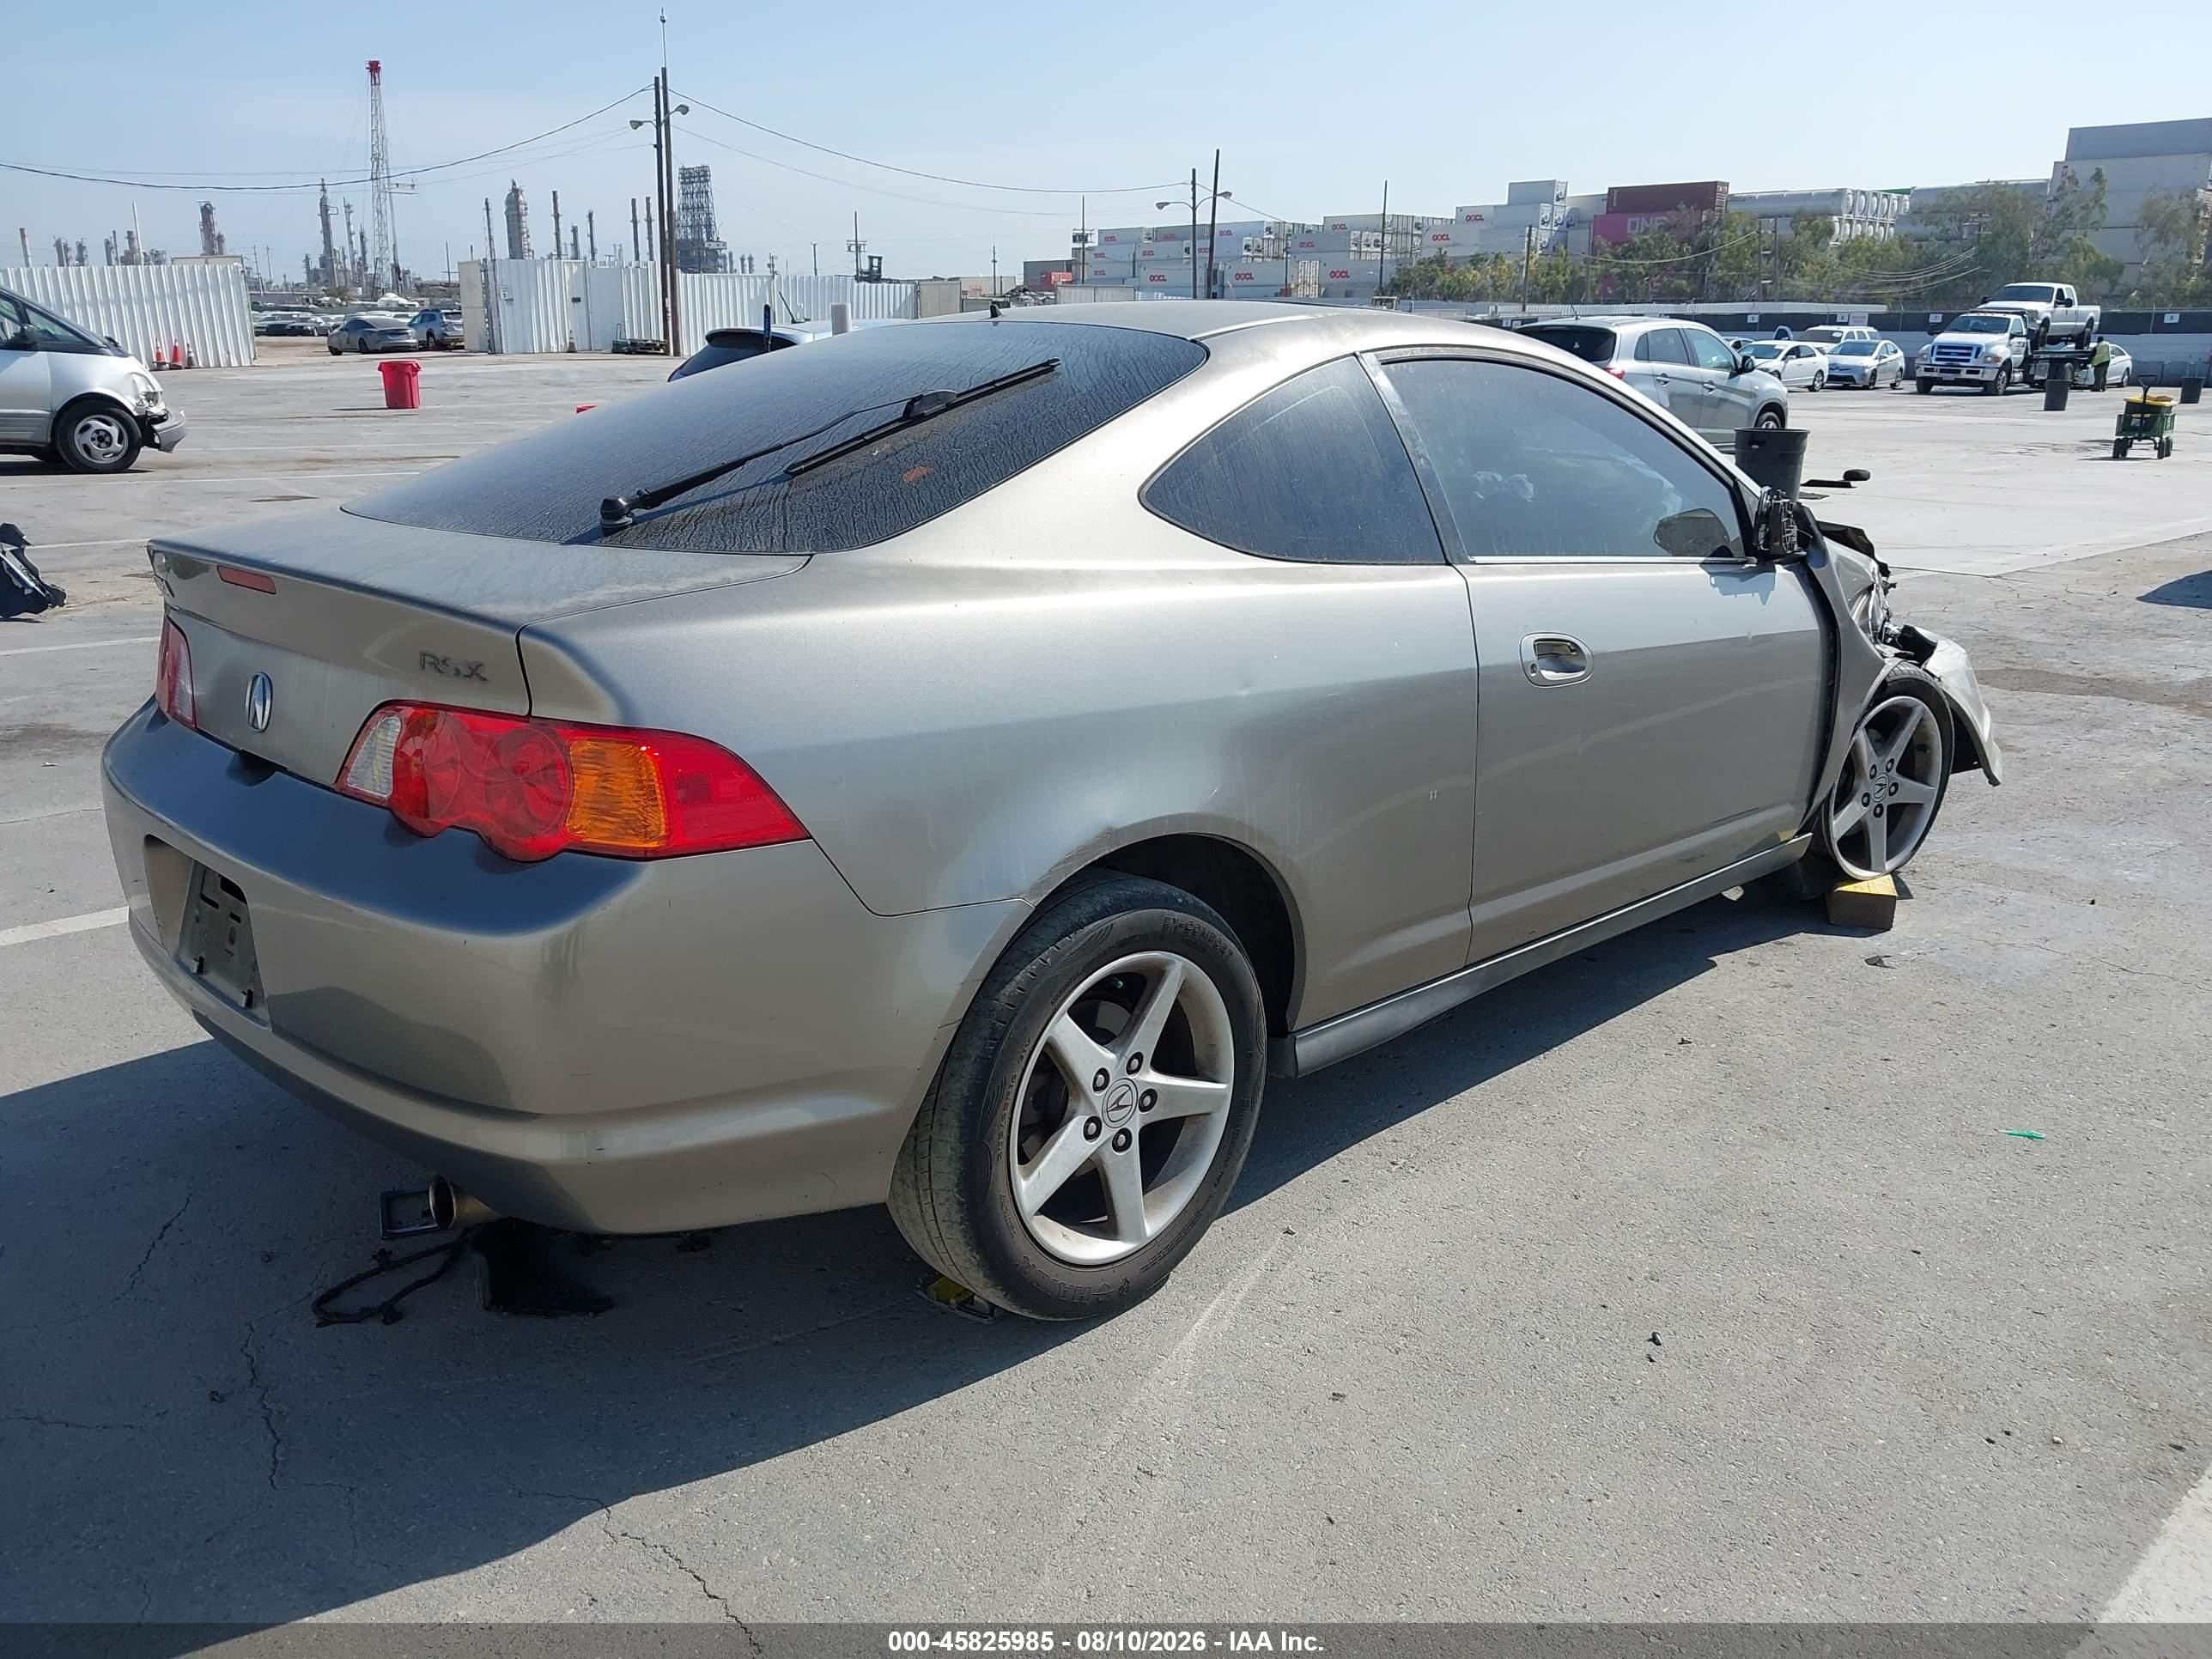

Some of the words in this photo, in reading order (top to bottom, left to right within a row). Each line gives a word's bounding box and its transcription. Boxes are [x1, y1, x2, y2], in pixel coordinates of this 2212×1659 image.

[1465, 214, 1485, 222] OOCL
[1149, 274, 1167, 283] OOCL
[1234, 272, 1255, 281] OOCL
[1329, 270, 1351, 279] OOCL
[419, 651, 488, 683] RSX
